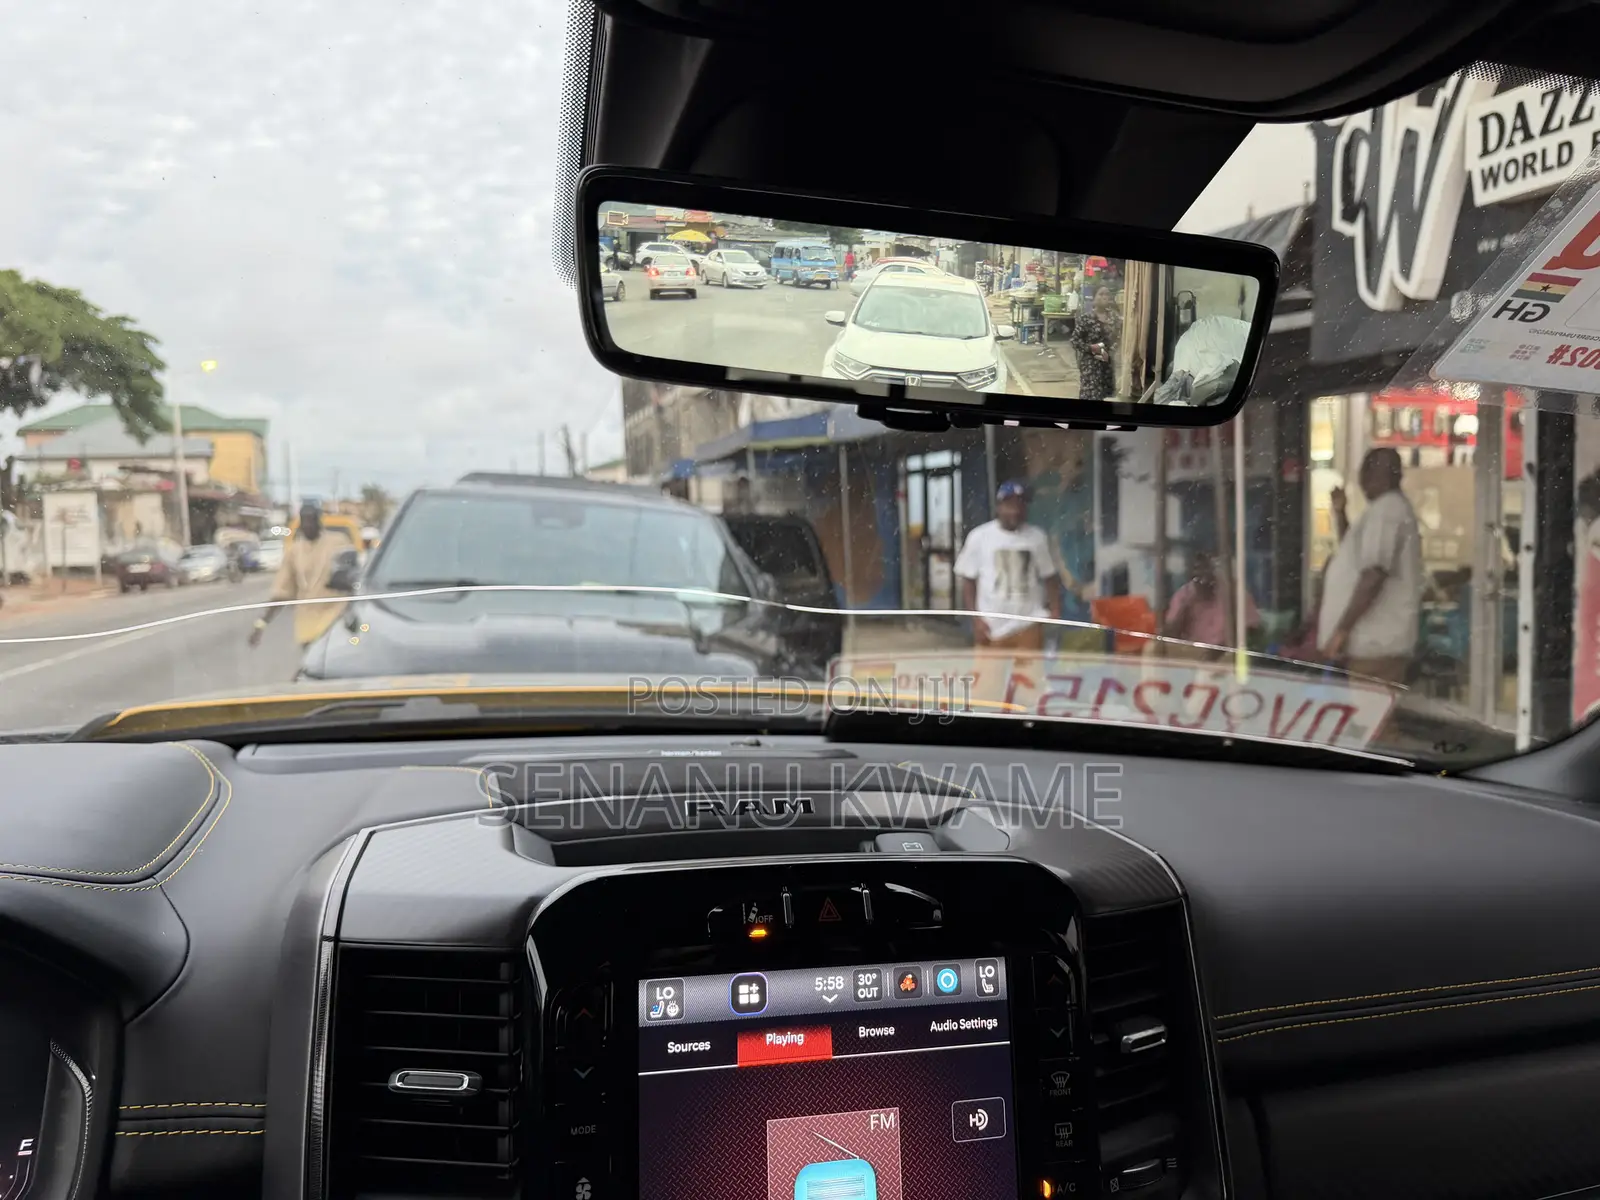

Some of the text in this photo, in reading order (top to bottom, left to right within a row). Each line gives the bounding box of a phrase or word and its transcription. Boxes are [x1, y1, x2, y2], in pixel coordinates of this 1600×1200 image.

[1481, 140, 1574, 193] WORLD
[684, 797, 815, 817] RAM
[758, 914, 774, 924] OFF
[979, 965, 995, 979] LO
[814, 976, 845, 992] 5:58
[857, 973, 878, 986] 30°
[656, 986, 675, 1001] LO
[857, 986, 879, 999] OUT
[930, 1016, 998, 1032] Audio Settings
[858, 1025, 895, 1038] Browse
[765, 1031, 804, 1046] Playing
[667, 1041, 711, 1054] Sources
[1050, 1088, 1072, 1097] FRONT
[869, 1112, 896, 1131] FM
[570, 1124, 597, 1136] MODE
[1055, 1139, 1073, 1148] REAR
[1056, 1182, 1077, 1195] A/C
